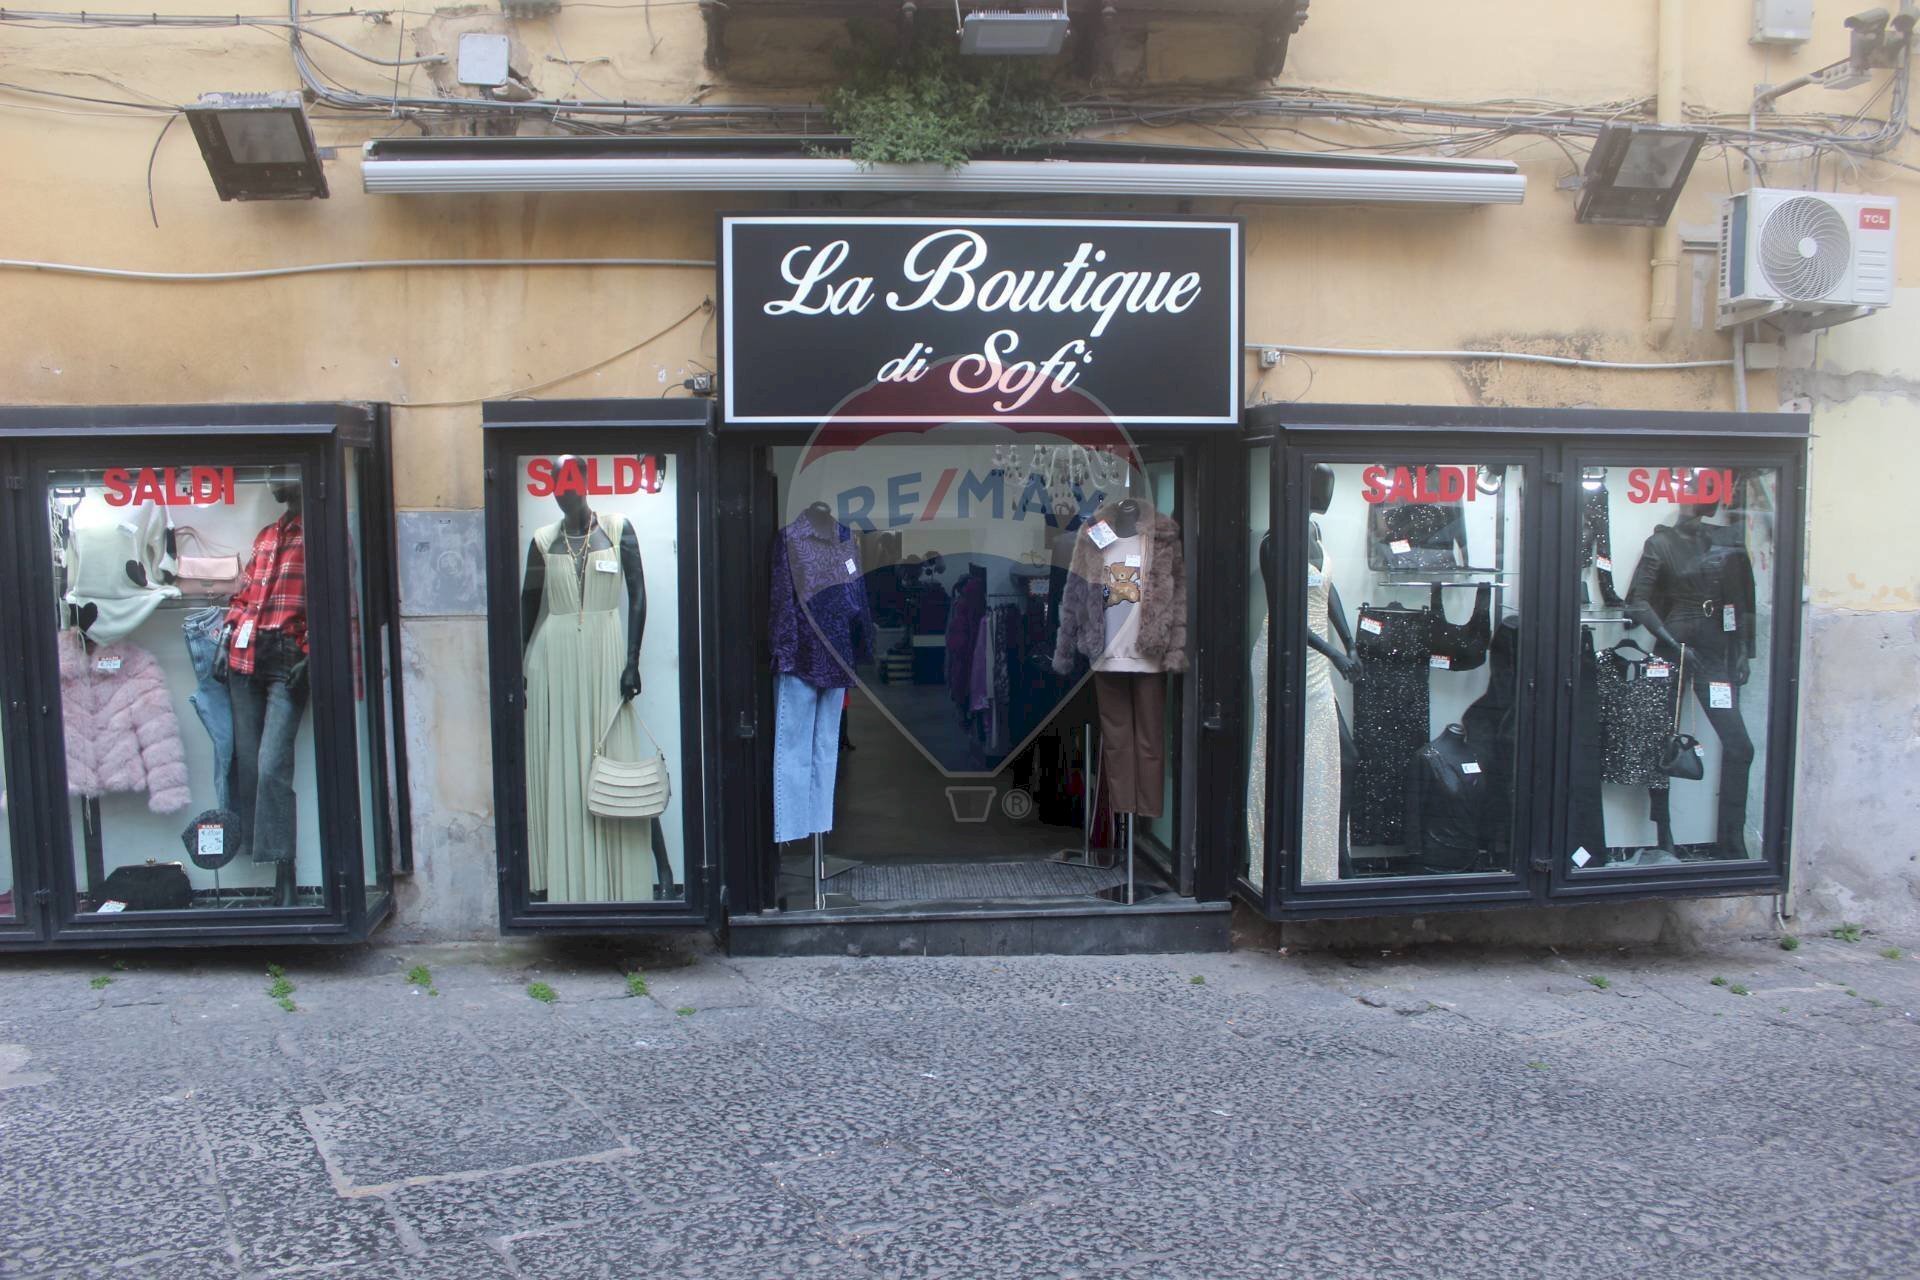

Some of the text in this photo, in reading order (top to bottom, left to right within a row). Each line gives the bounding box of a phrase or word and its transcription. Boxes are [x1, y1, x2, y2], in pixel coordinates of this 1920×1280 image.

[1863, 213, 1887, 225] TCL
[763, 228, 1202, 338] La Boutique
[876, 342, 934, 383] di
[103, 467, 235, 507] SALDI
[527, 457, 656, 497] SALDI
[1362, 466, 1477, 504] SALDI
[1627, 468, 1733, 505] SALDI
